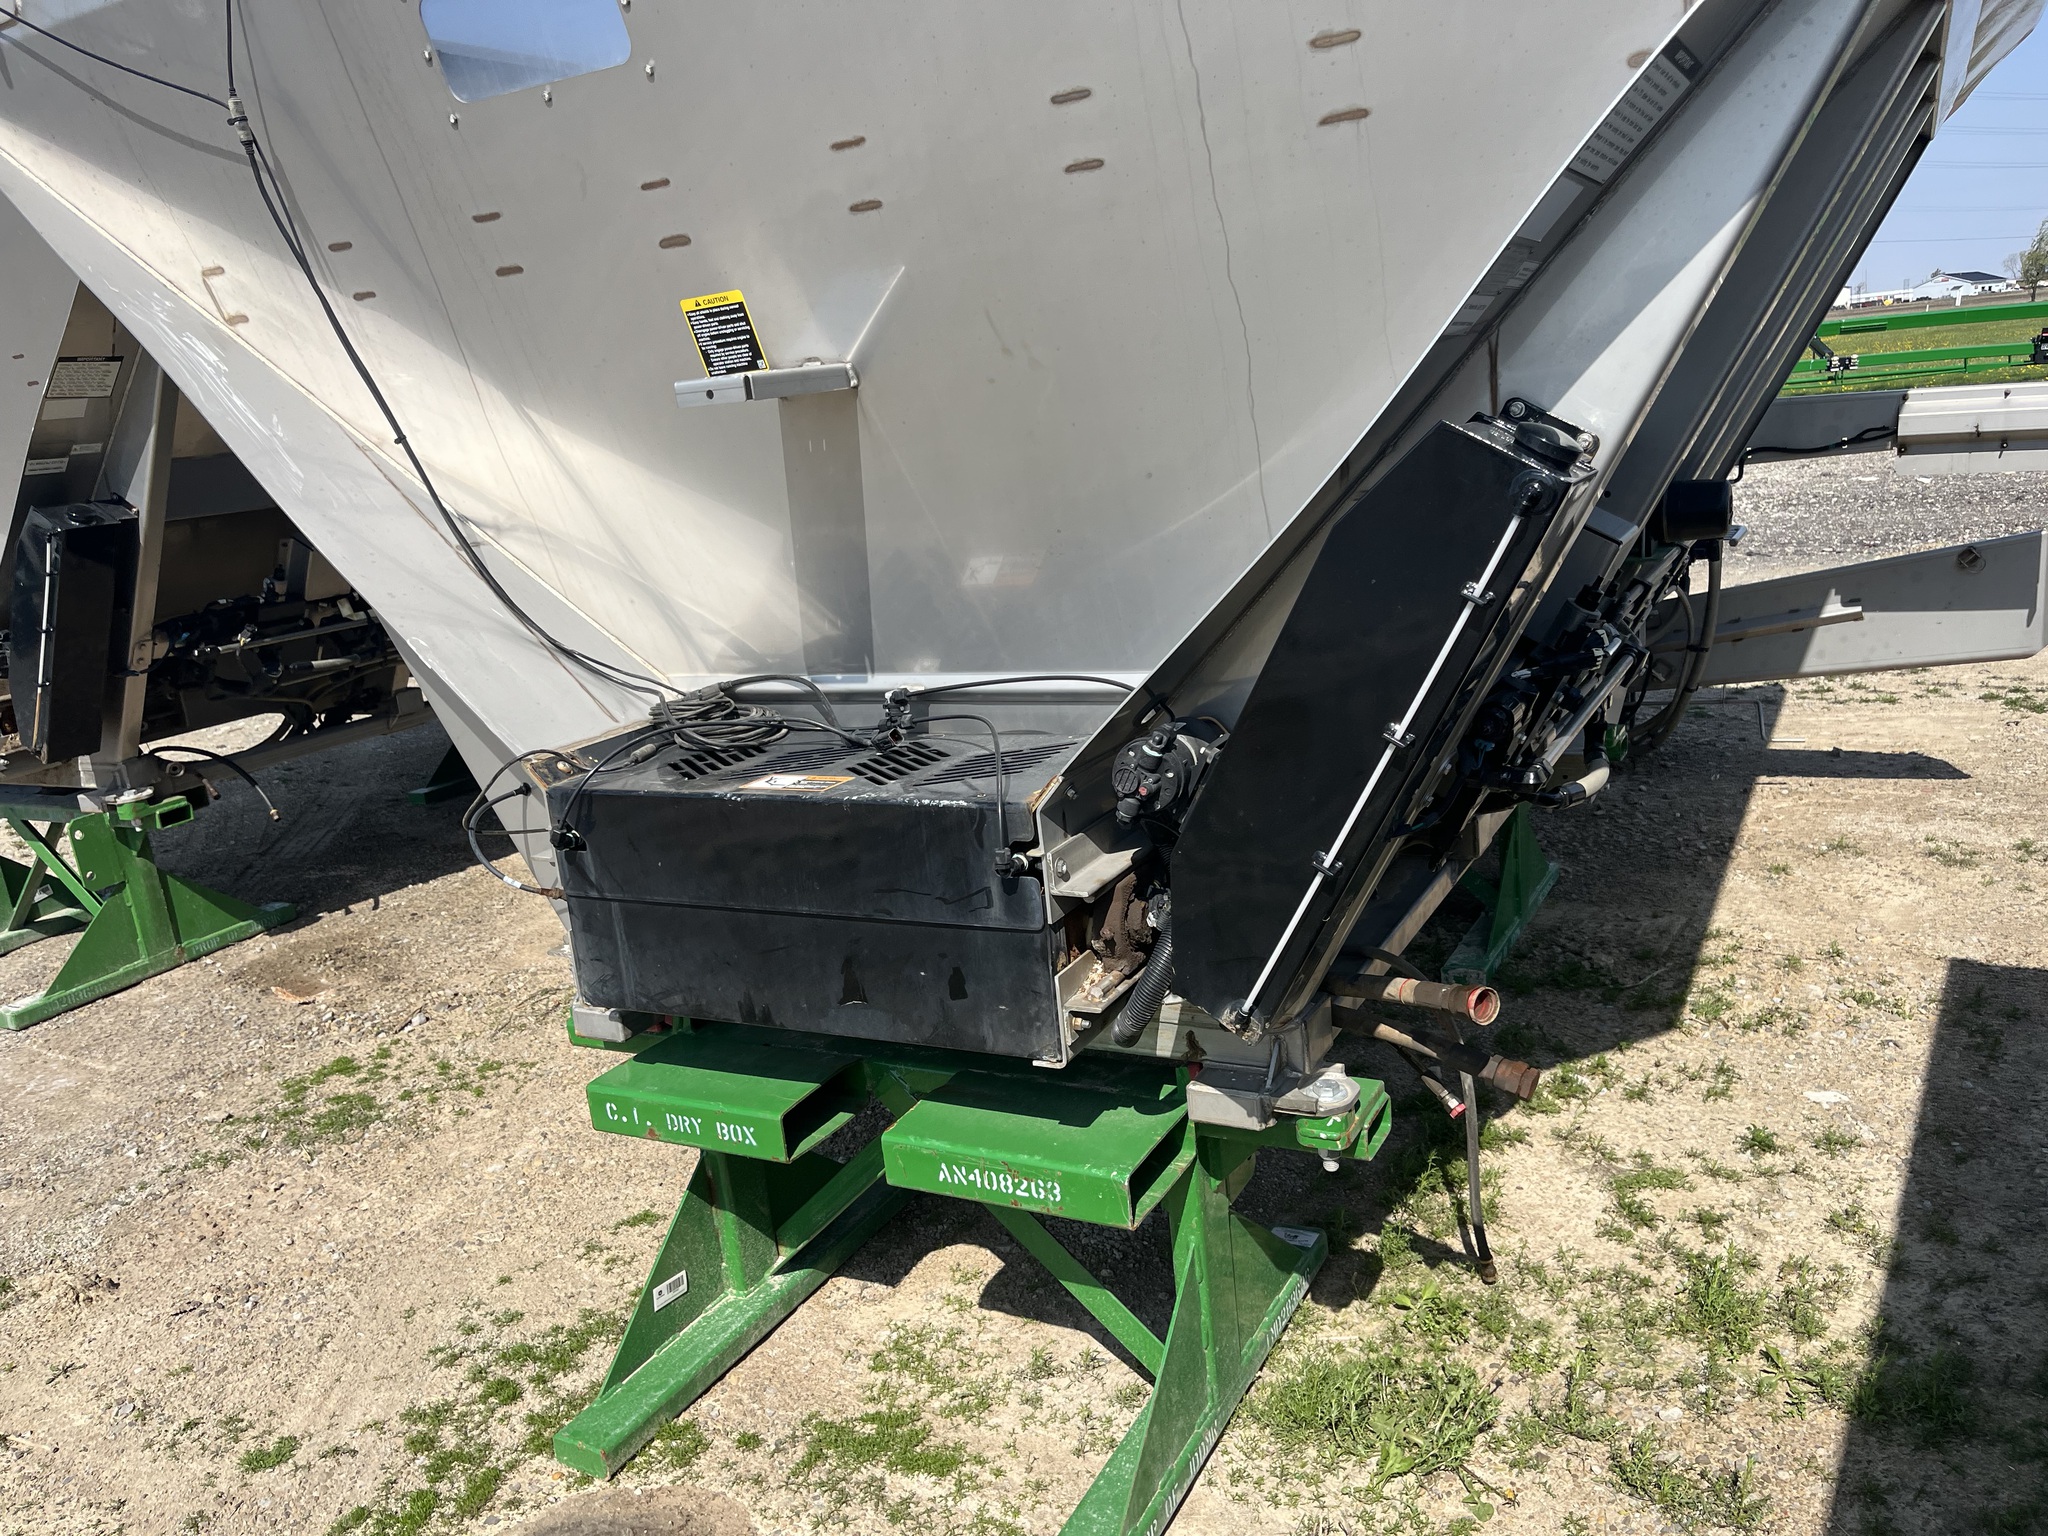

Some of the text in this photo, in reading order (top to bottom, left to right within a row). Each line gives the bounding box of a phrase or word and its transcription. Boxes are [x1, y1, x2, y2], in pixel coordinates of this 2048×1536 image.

[702, 296, 729, 306] CAUTION
[192, 937, 220, 955] PROP
[665, 1112, 702, 1136] DRY
[715, 1121, 758, 1147] BOX
[938, 1162, 1061, 1202] AN408263
